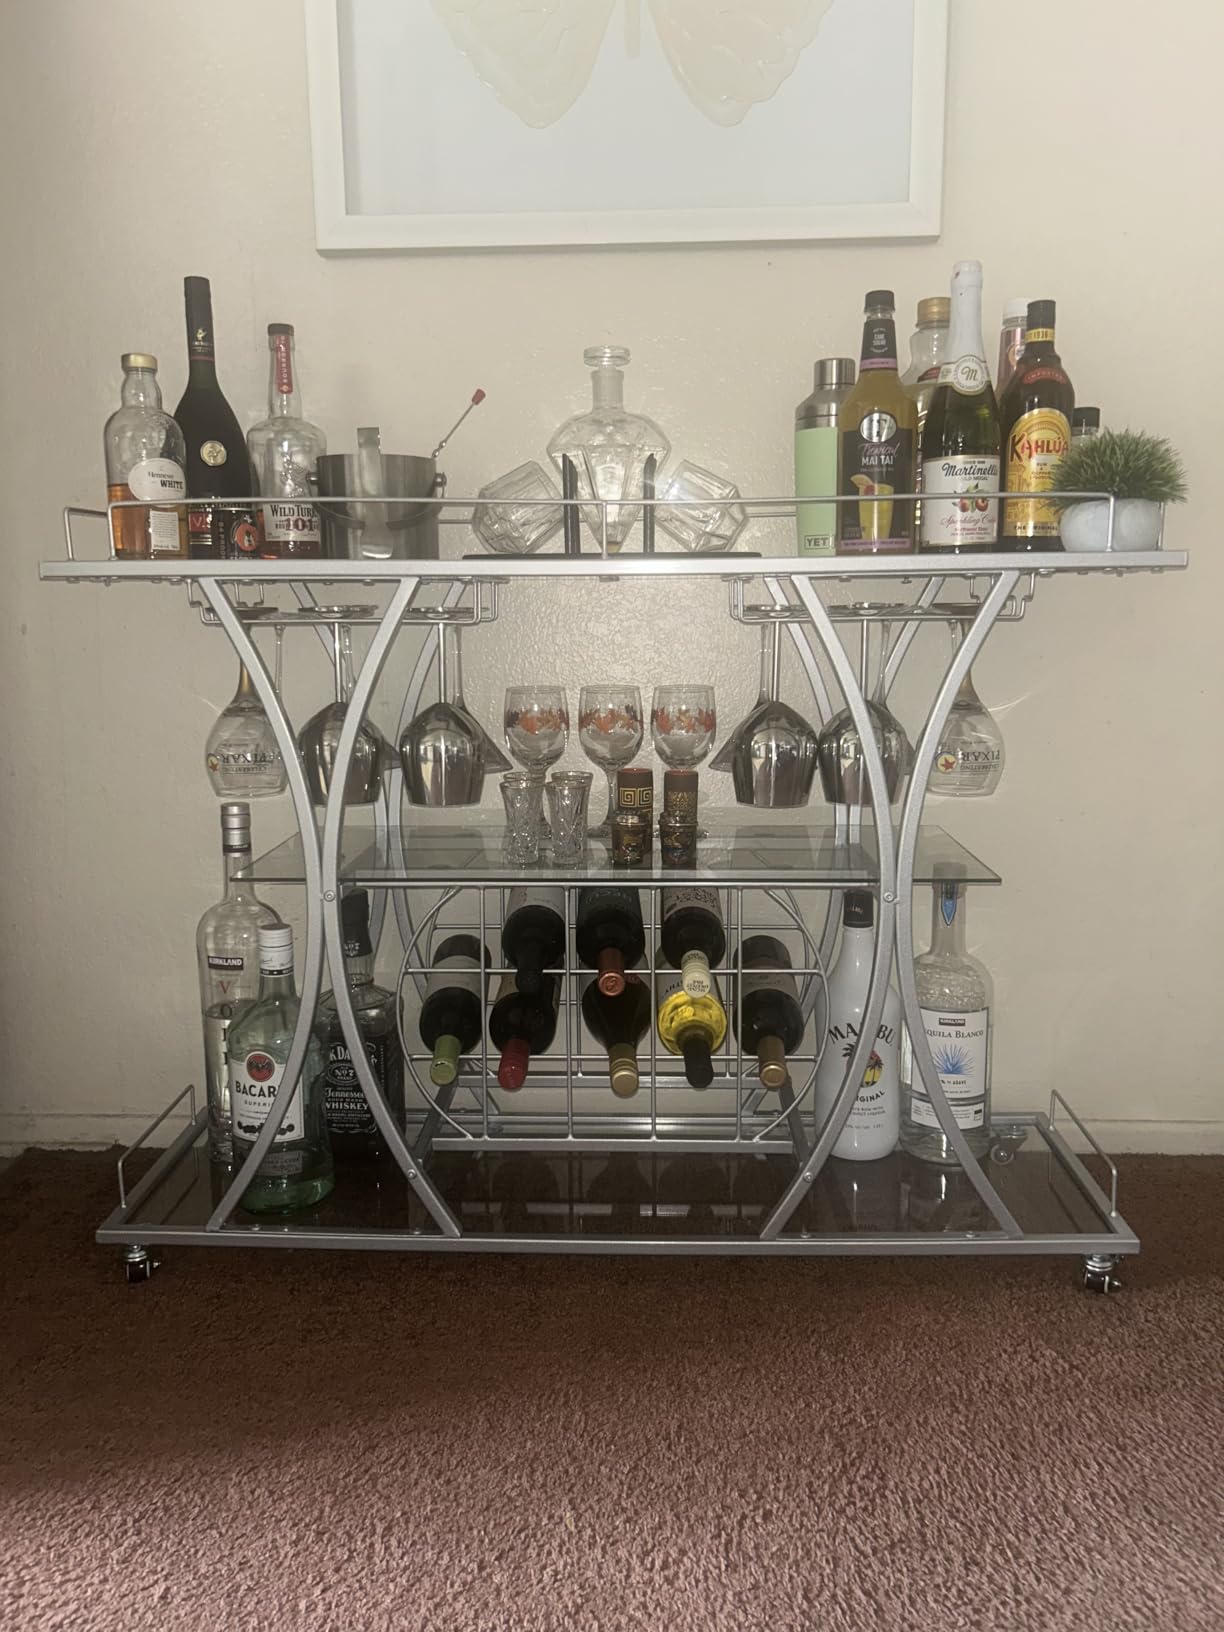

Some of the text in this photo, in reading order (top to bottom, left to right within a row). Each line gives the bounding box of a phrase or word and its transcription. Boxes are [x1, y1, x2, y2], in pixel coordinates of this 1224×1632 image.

[1010, 432, 1069, 463] KAHLÚA
[861, 455, 894, 466] MAI TAI
[160, 480, 184, 490] WHITE
[270, 504, 318, 518] WILD TURK
[286, 518, 314, 532] 101
[806, 537, 833, 547] YET
[209, 957, 242, 966] KIRKLAND
[828, 1023, 895, 1045] MABU
[926, 1030, 984, 1038] QUILA BLANCO
[235, 1081, 280, 1098] BACAR
[856, 1089, 885, 1102] IGINAL
